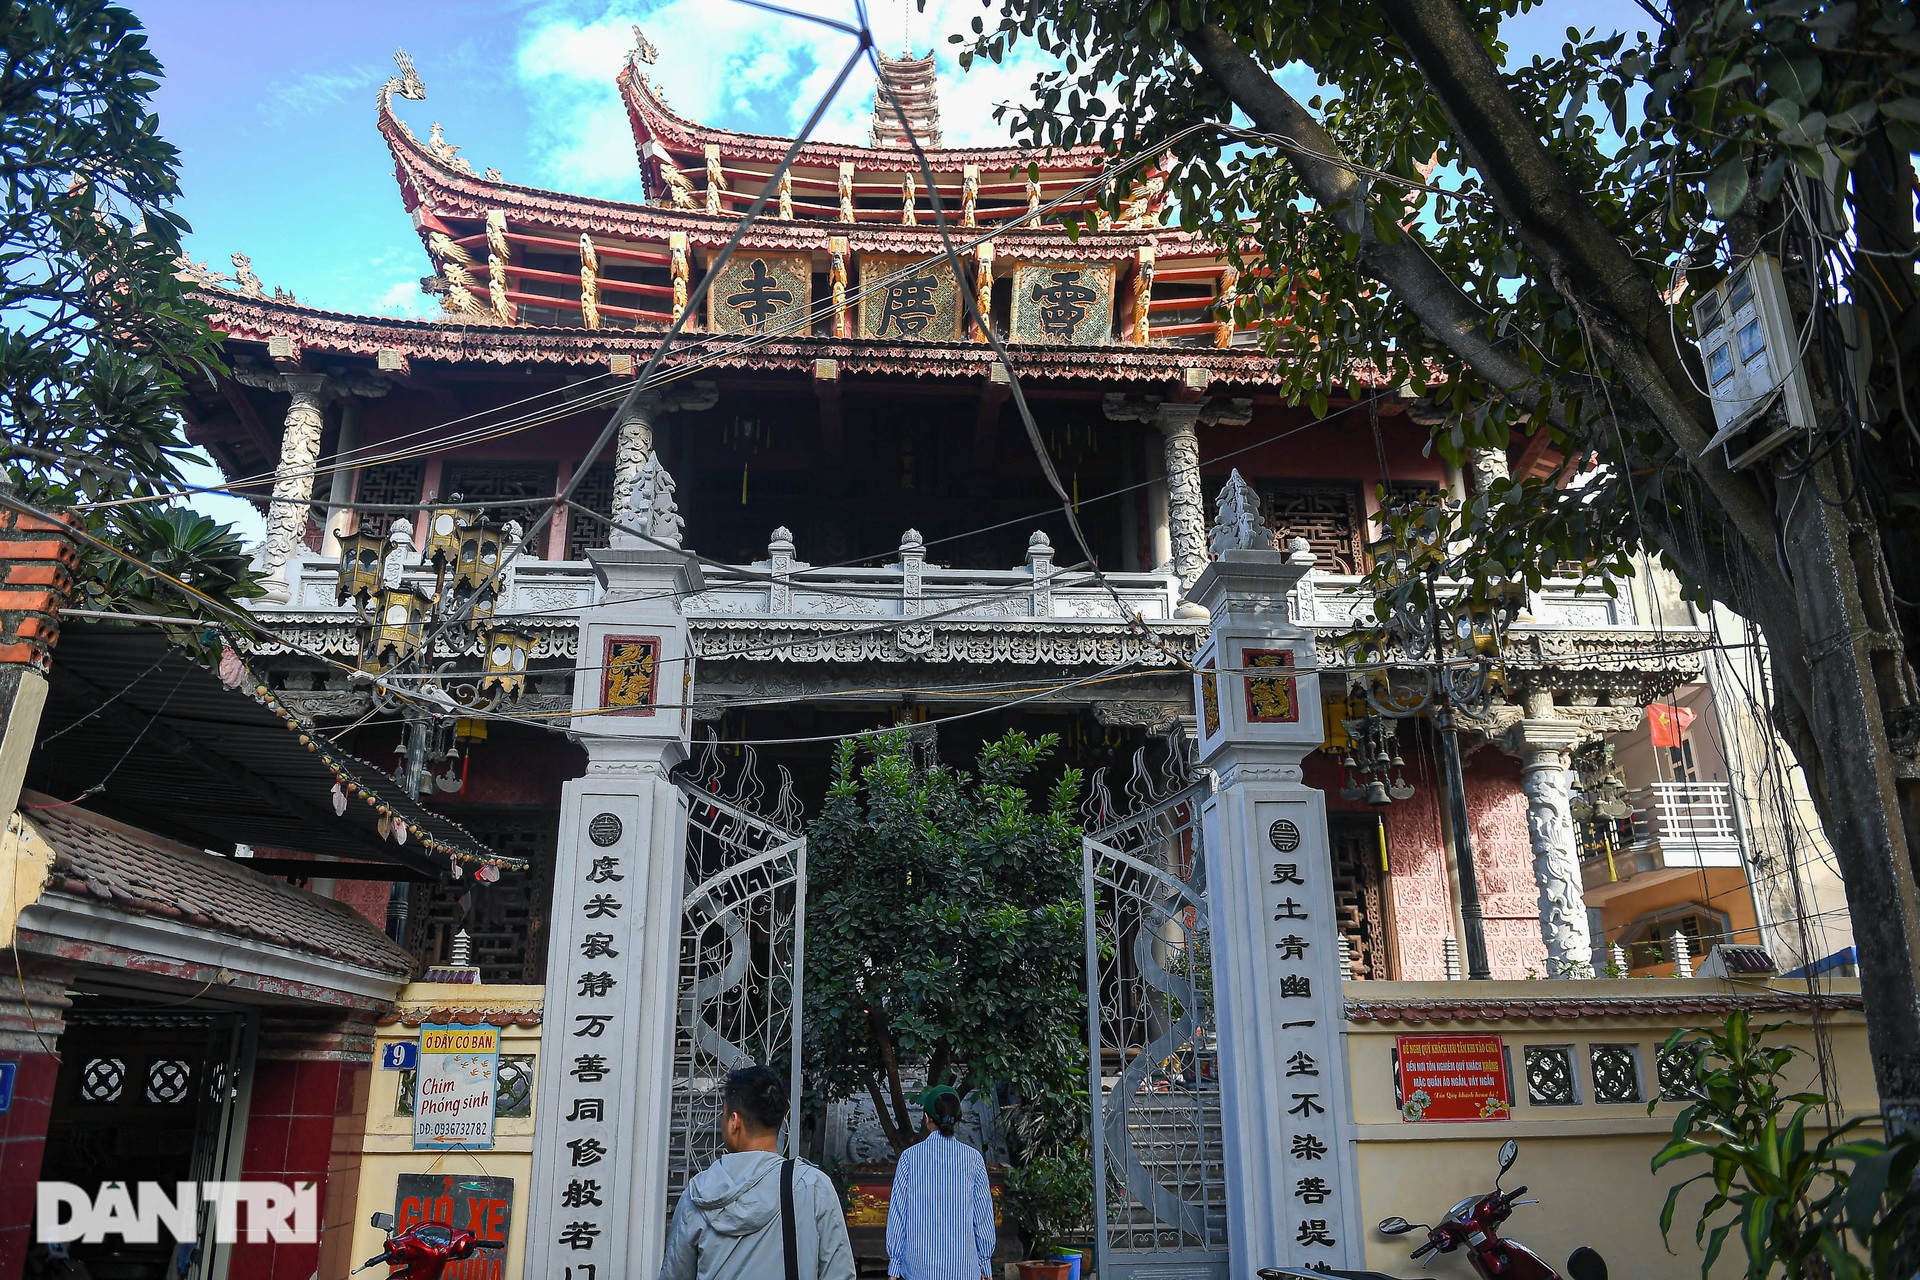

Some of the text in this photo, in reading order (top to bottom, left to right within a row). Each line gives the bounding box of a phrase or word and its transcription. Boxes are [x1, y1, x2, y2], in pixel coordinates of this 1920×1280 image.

[725, 258, 795, 333] 寺
[455, 1032, 470, 1049] CÓ
[392, 1045, 406, 1066] 9
[422, 1078, 455, 1096] Chim
[420, 1091, 489, 1117] Phóng sinh
[434, 1122, 487, 1136] 0936732782
[466, 1197, 506, 1240] XE
